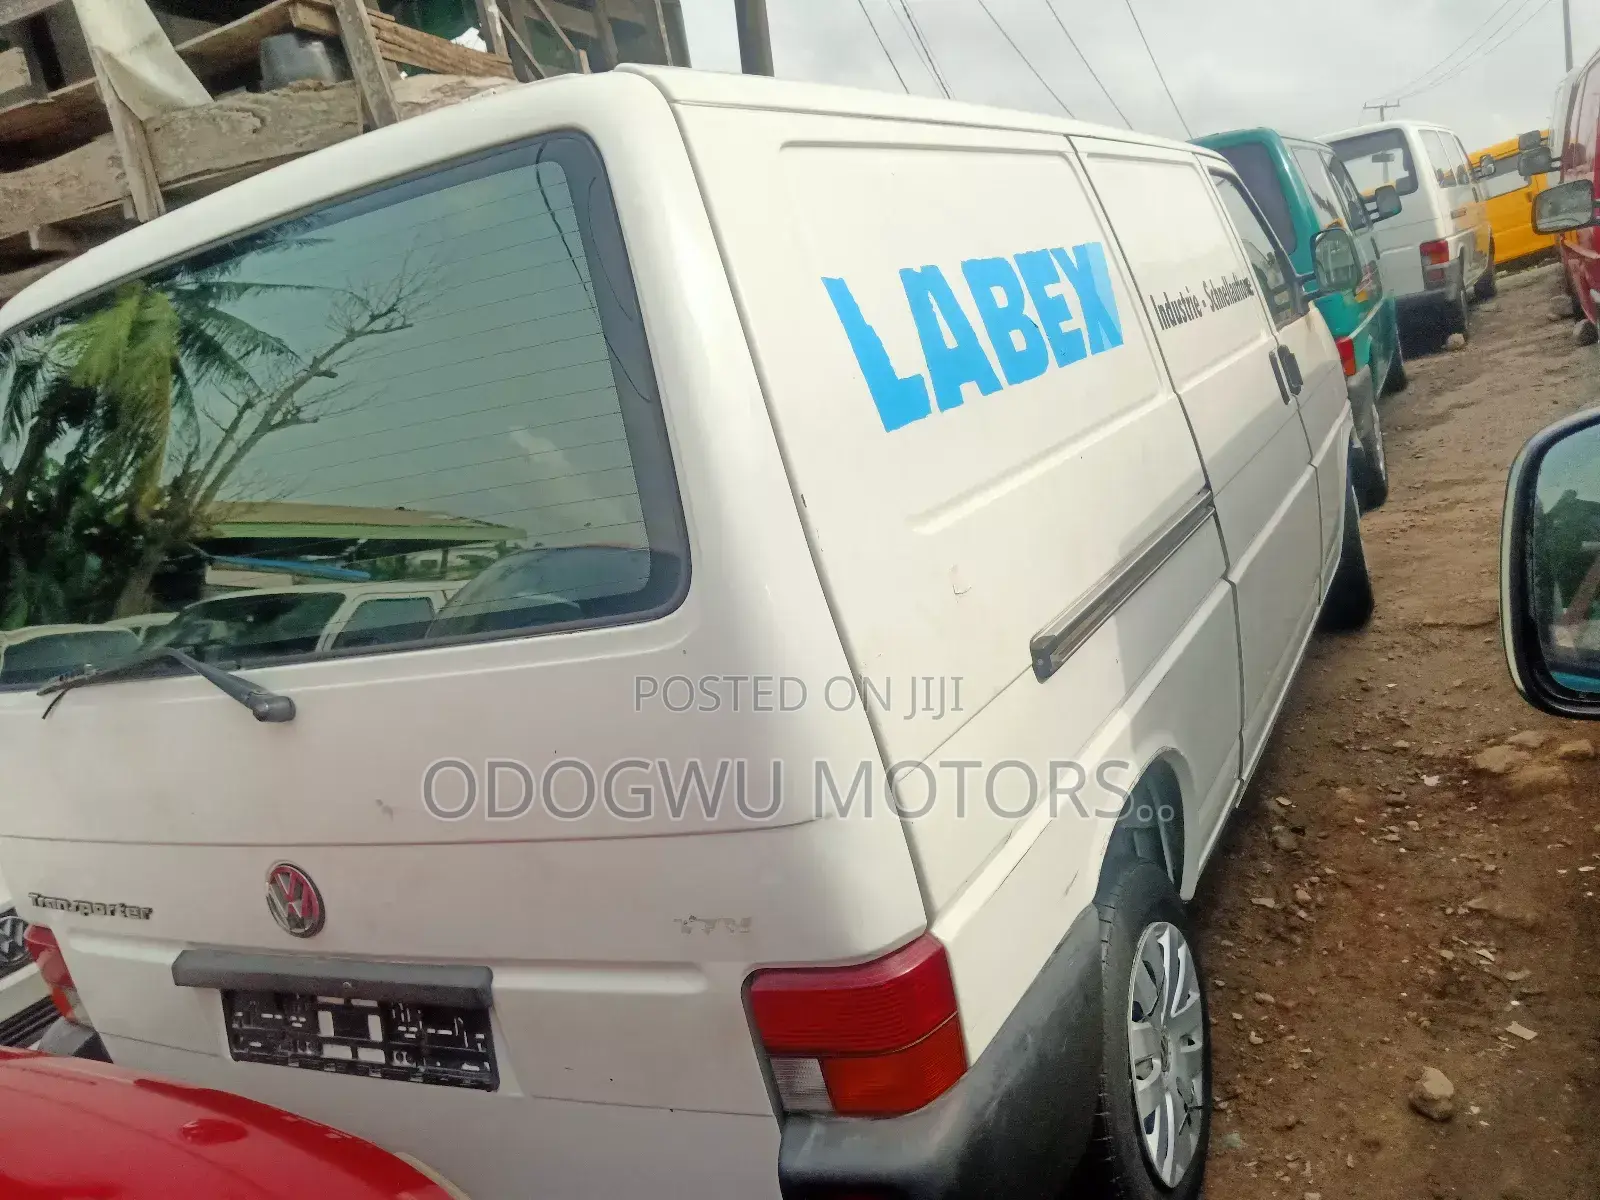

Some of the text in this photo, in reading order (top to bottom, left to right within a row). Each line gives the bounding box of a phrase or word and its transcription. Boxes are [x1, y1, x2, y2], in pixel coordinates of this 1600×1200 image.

[1149, 294, 1202, 330] Industrie
[821, 242, 1124, 432] LABEX
[28, 892, 153, 920] Transporter
